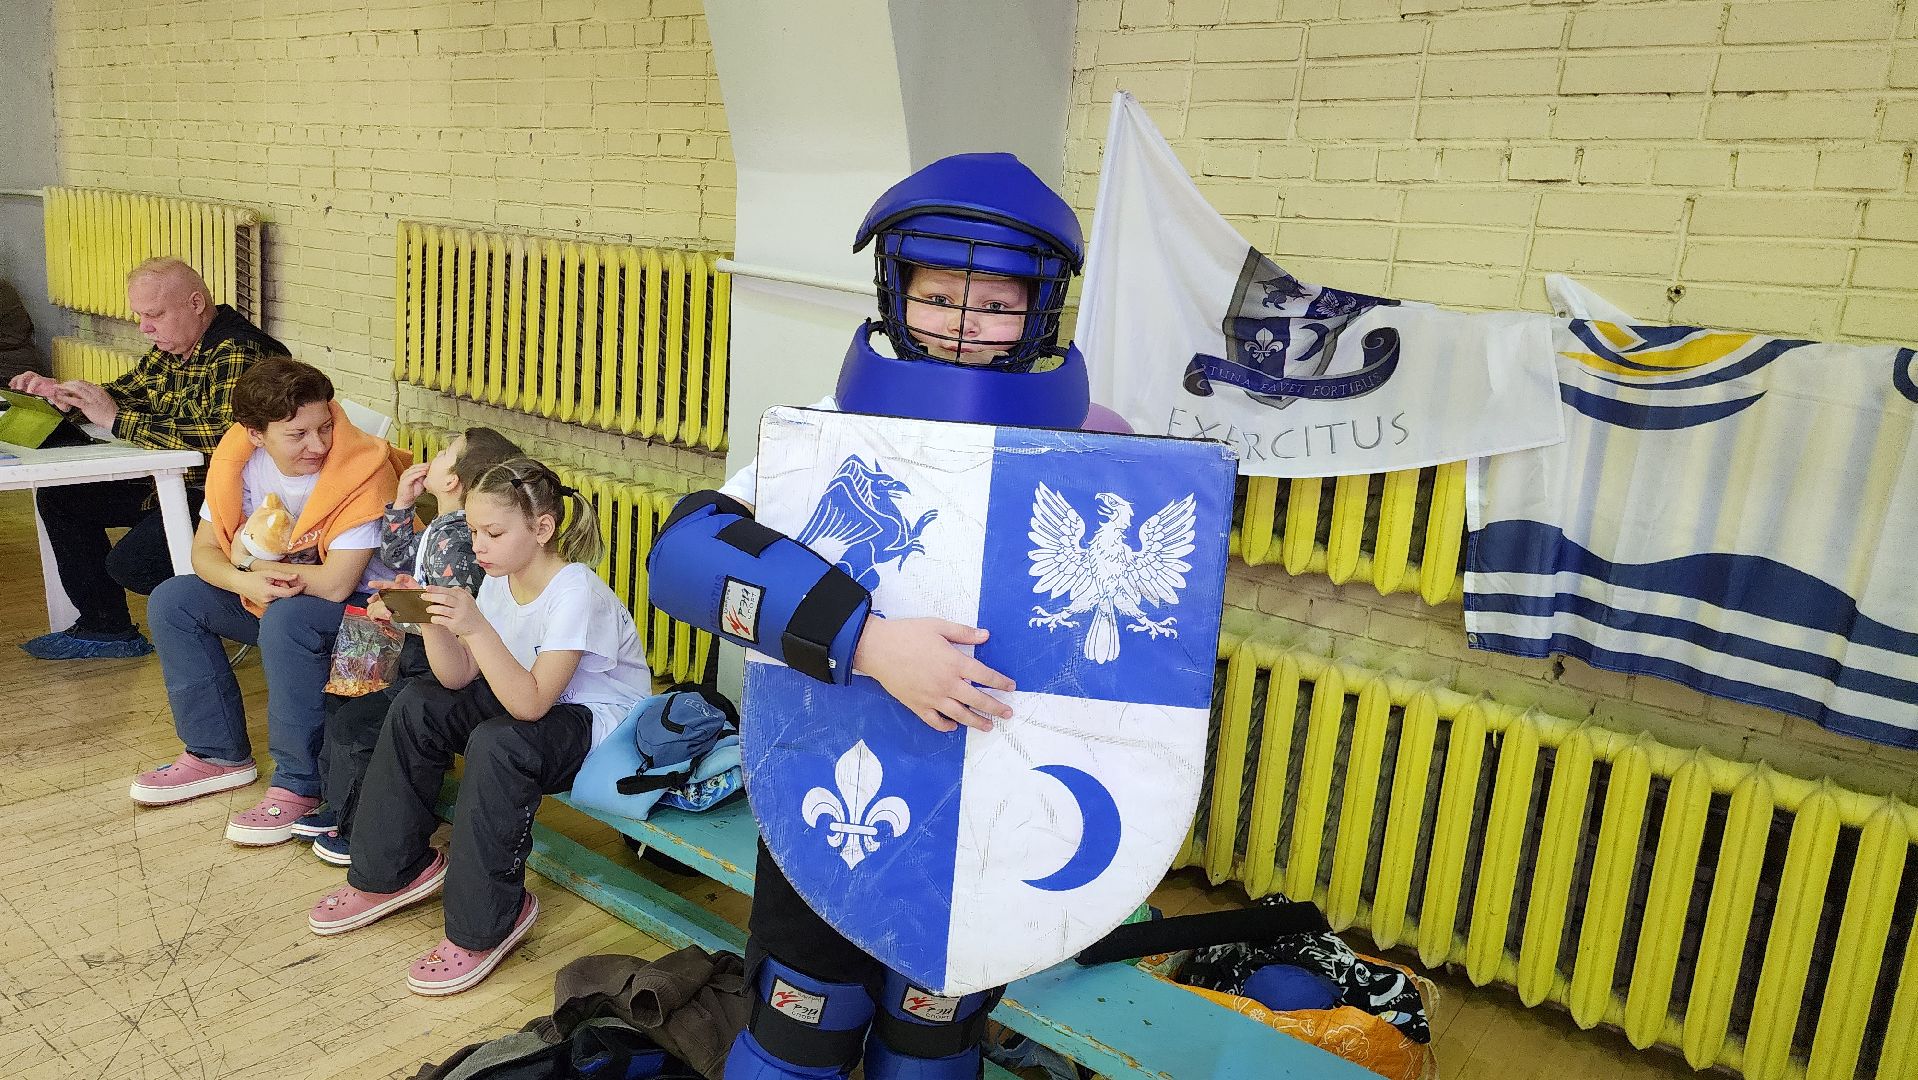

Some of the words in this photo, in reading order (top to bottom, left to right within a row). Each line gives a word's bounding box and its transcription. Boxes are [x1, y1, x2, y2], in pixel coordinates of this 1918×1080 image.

[1260, 380, 1306, 394] FAVET
[1312, 371, 1383, 397] FORTIBUS
[1167, 406, 1409, 461] EXERCITUS
[791, 1011, 816, 1021] СПОРТ
